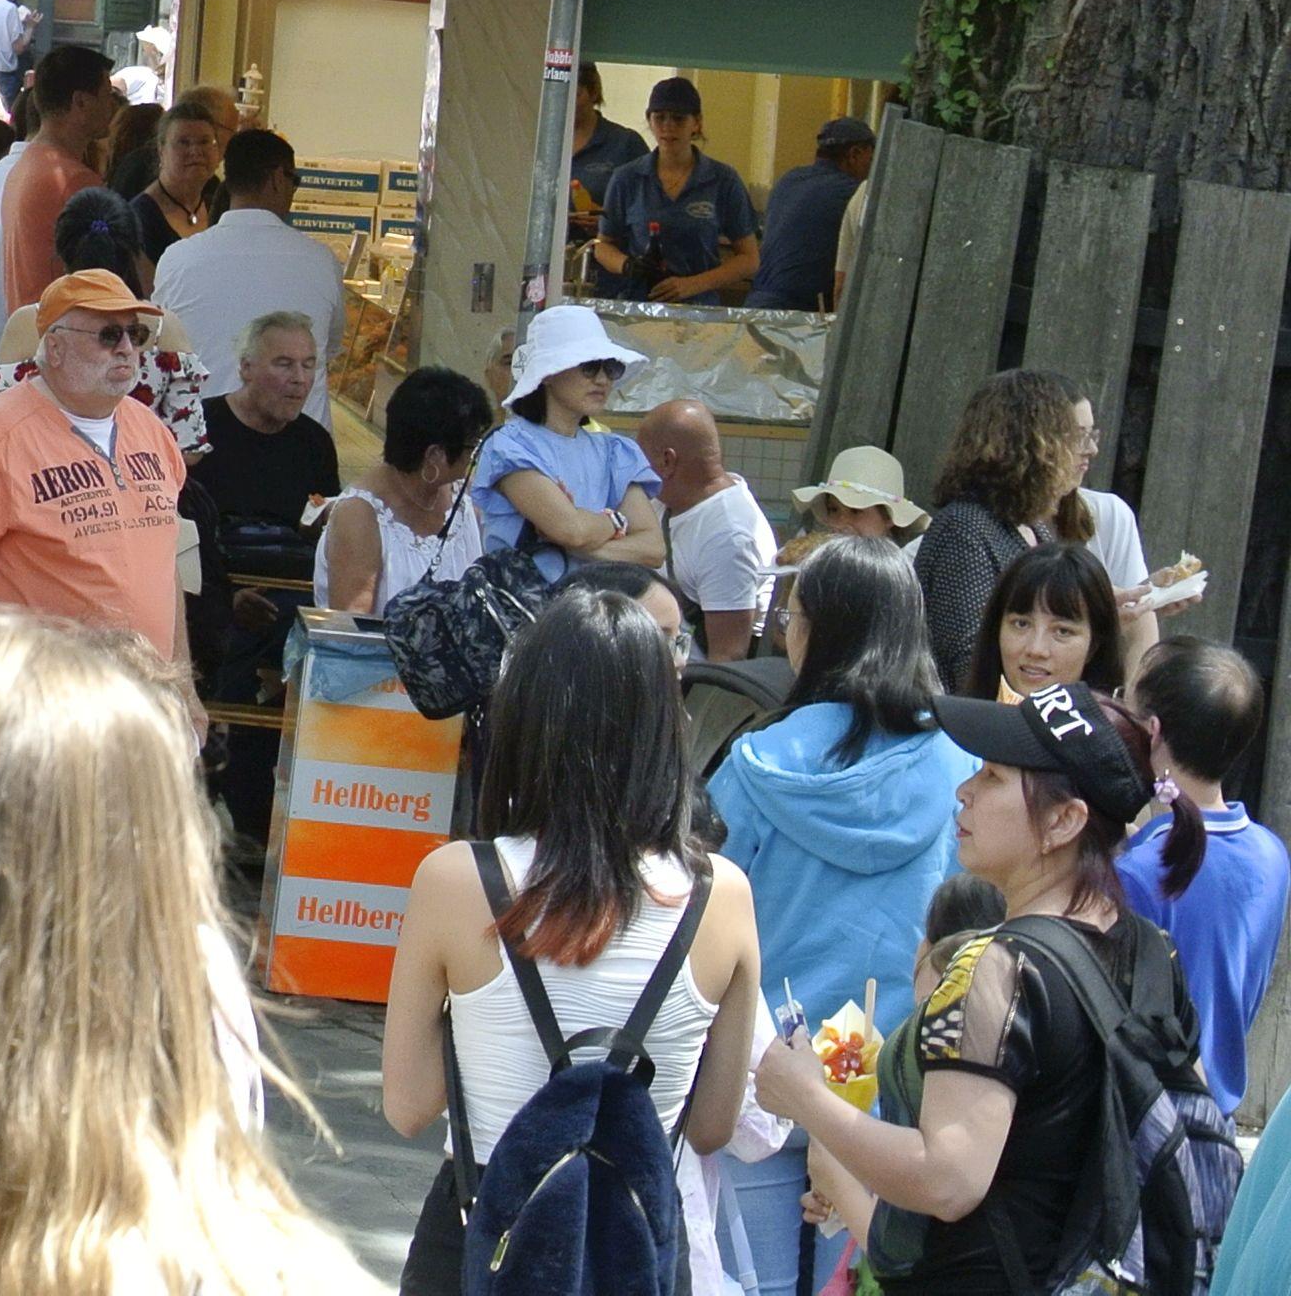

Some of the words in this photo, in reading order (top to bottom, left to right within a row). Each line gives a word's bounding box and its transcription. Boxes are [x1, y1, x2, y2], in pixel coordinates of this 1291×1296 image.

[300, 175, 364, 188] SERVIETTEN
[291, 218, 356, 230] SERVIETTEN
[31, 460, 106, 504] AERON
[312, 778, 432, 822] Hellberg
